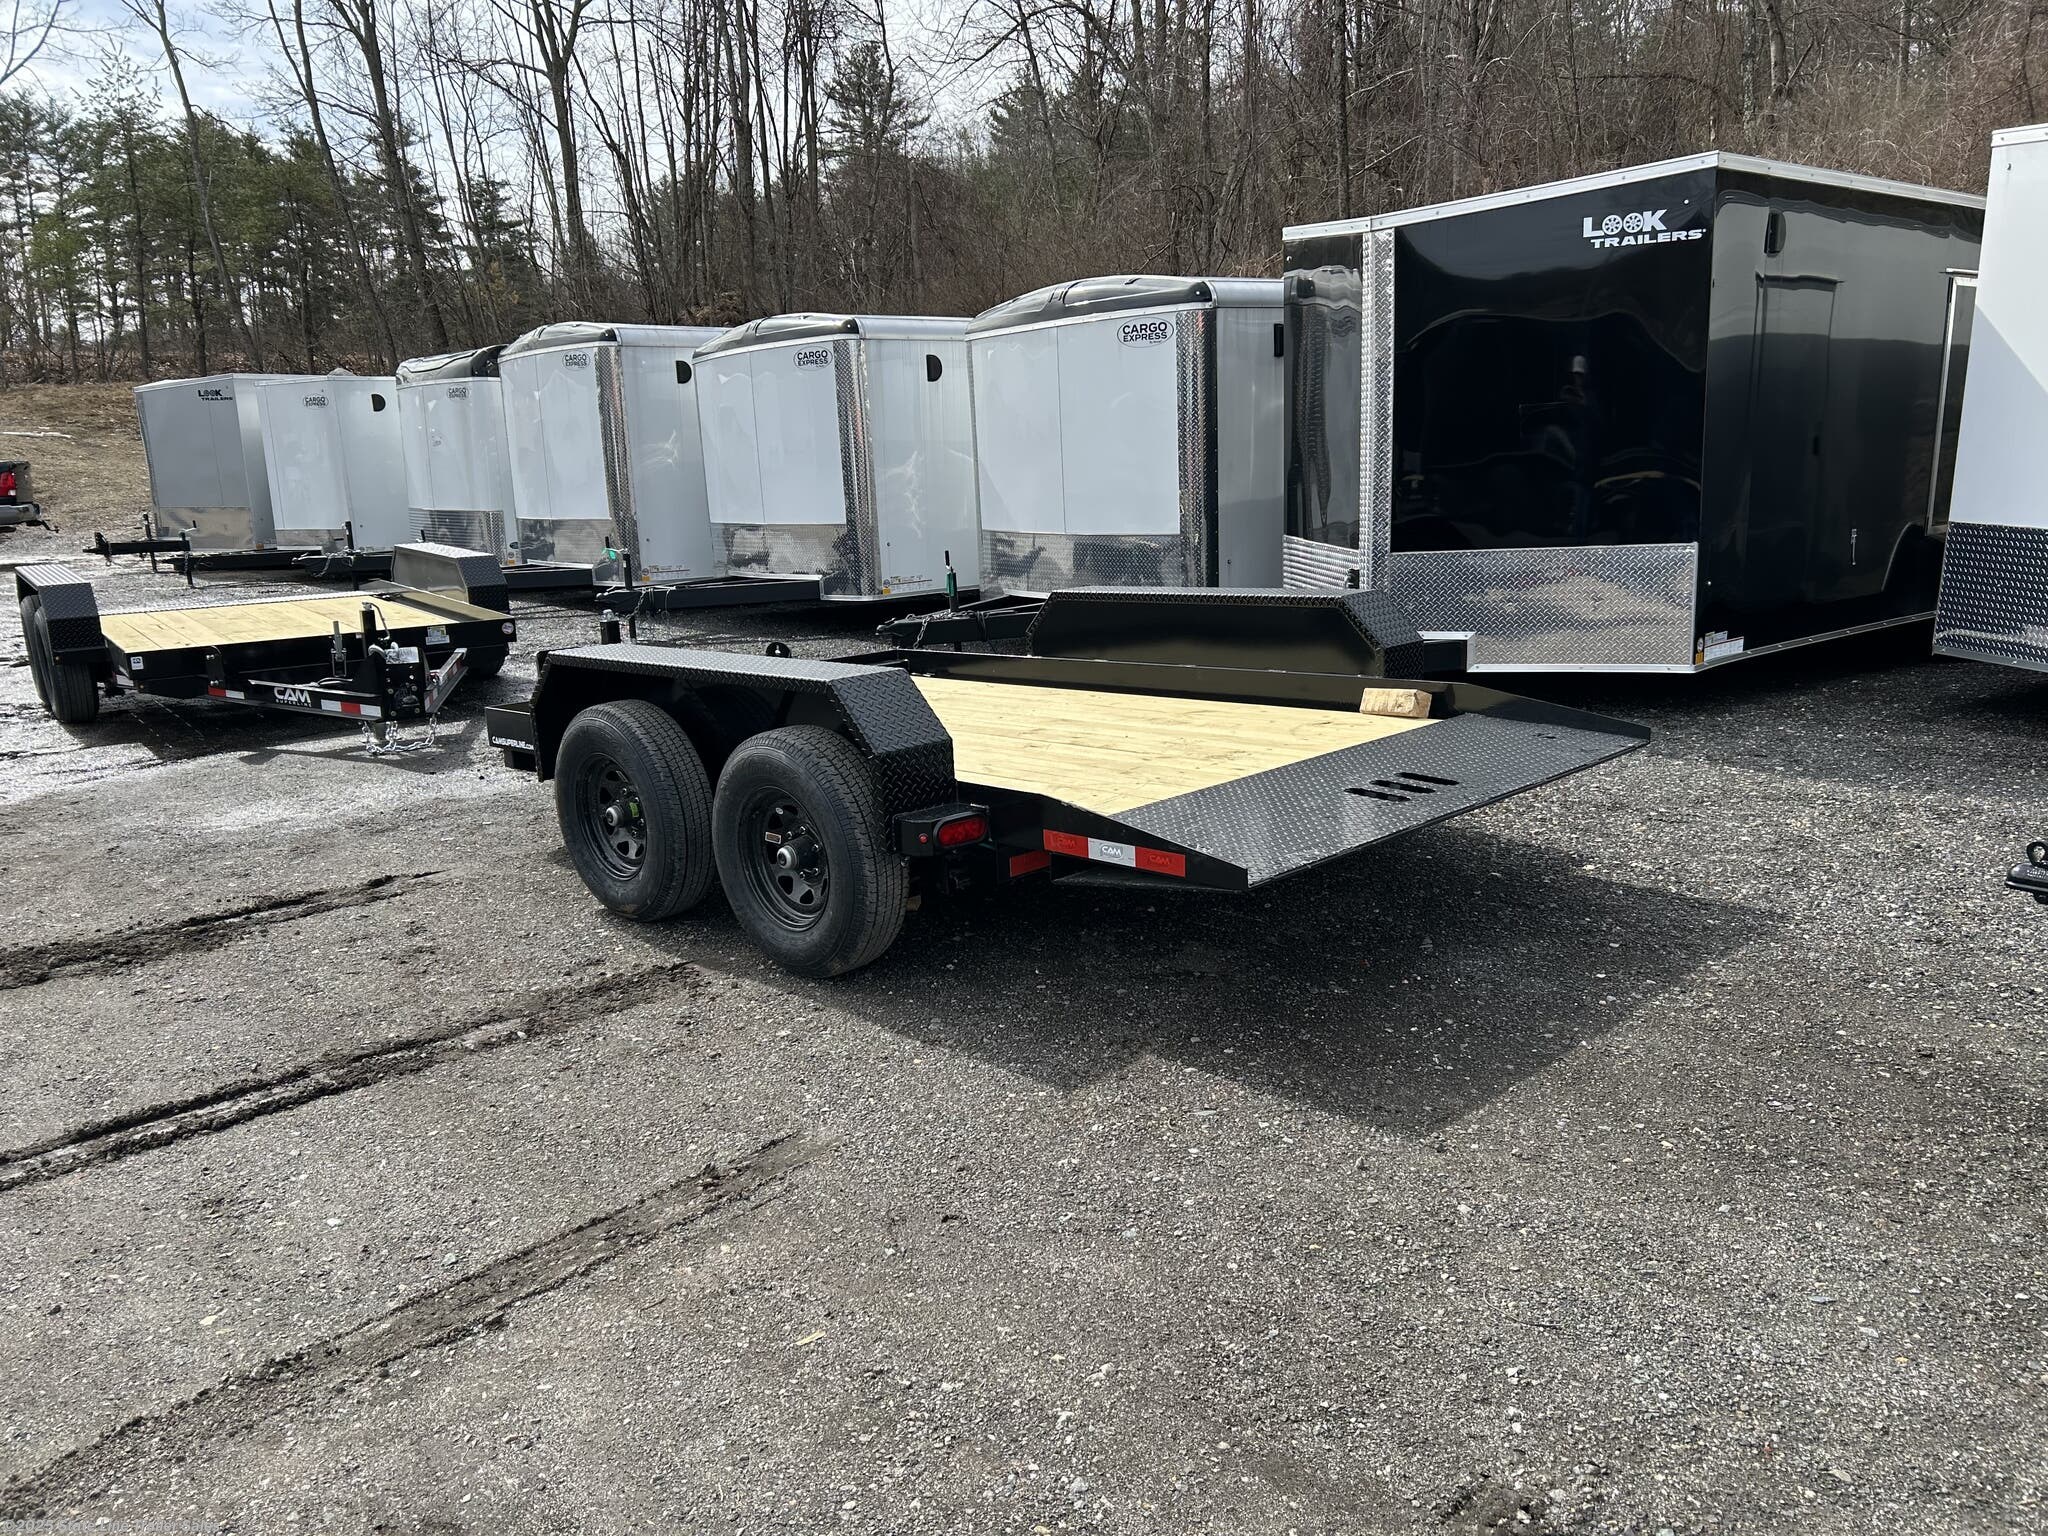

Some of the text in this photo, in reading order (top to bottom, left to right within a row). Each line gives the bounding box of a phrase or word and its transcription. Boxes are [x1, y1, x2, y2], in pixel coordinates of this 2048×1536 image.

[1583, 209, 1667, 238] LOOK
[1122, 321, 1167, 335] CARGO
[1123, 331, 1168, 343] EXPRESS
[565, 353, 587, 362] CARGO
[797, 350, 828, 361] CARGO
[798, 357, 828, 366] EXPRESS
[197, 389, 222, 397] LOOK
[274, 687, 312, 704] CAM
[1101, 845, 1122, 857] CAM
[1149, 854, 1171, 866] CAM
